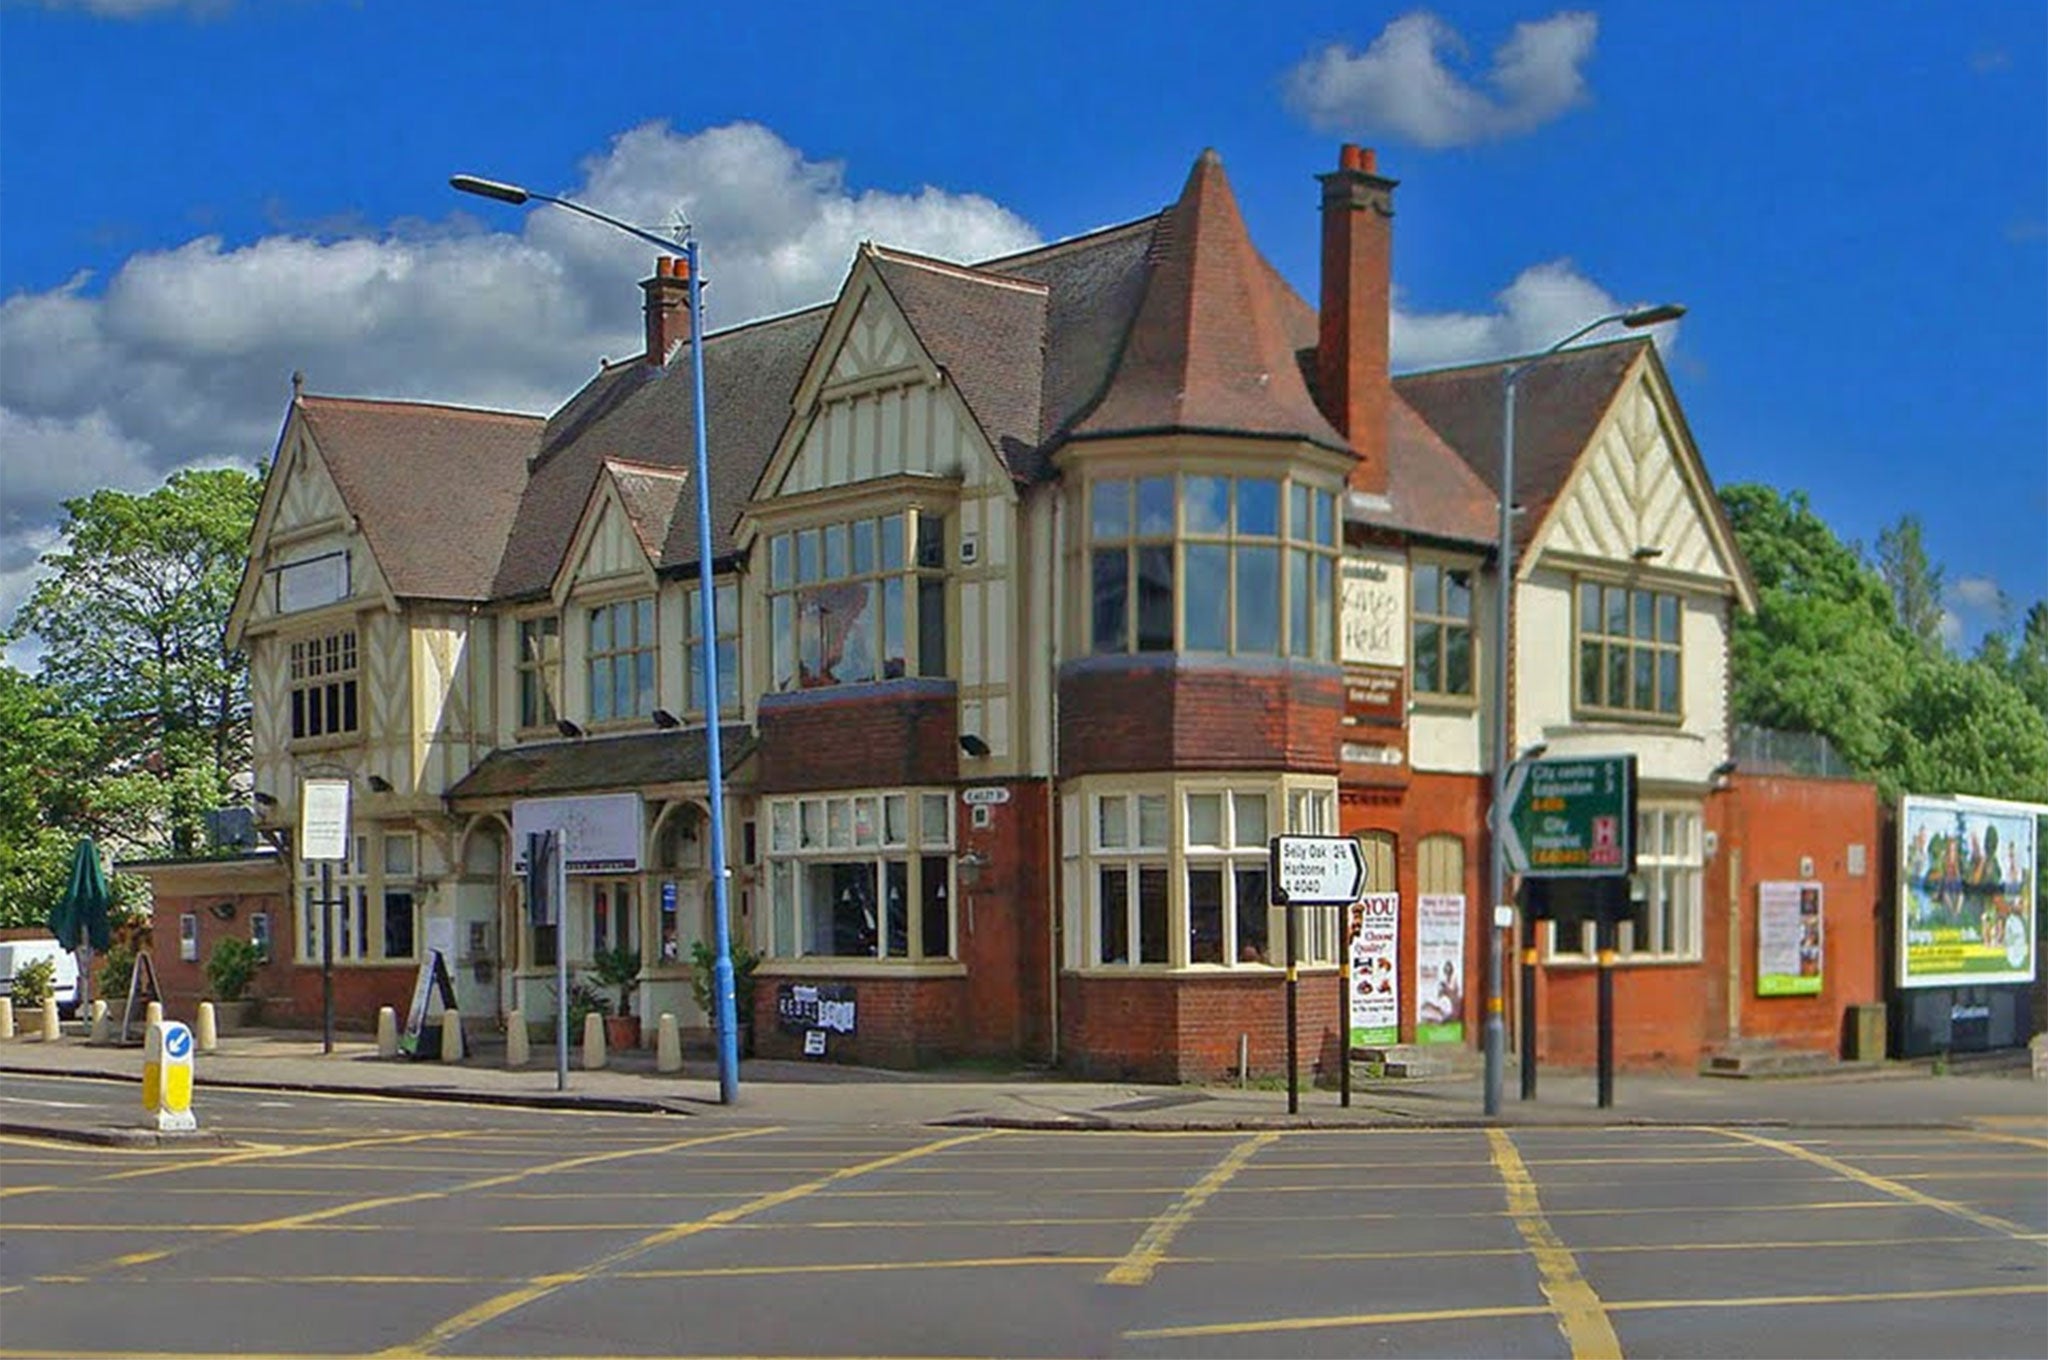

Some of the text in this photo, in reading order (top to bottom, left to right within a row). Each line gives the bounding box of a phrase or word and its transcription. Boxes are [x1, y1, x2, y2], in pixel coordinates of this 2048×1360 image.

[1284, 843, 1306, 860] Selly
[1309, 844, 1326, 858] Oak
[1284, 862, 1326, 876] Harborne
[1364, 898, 1395, 916] YOU
